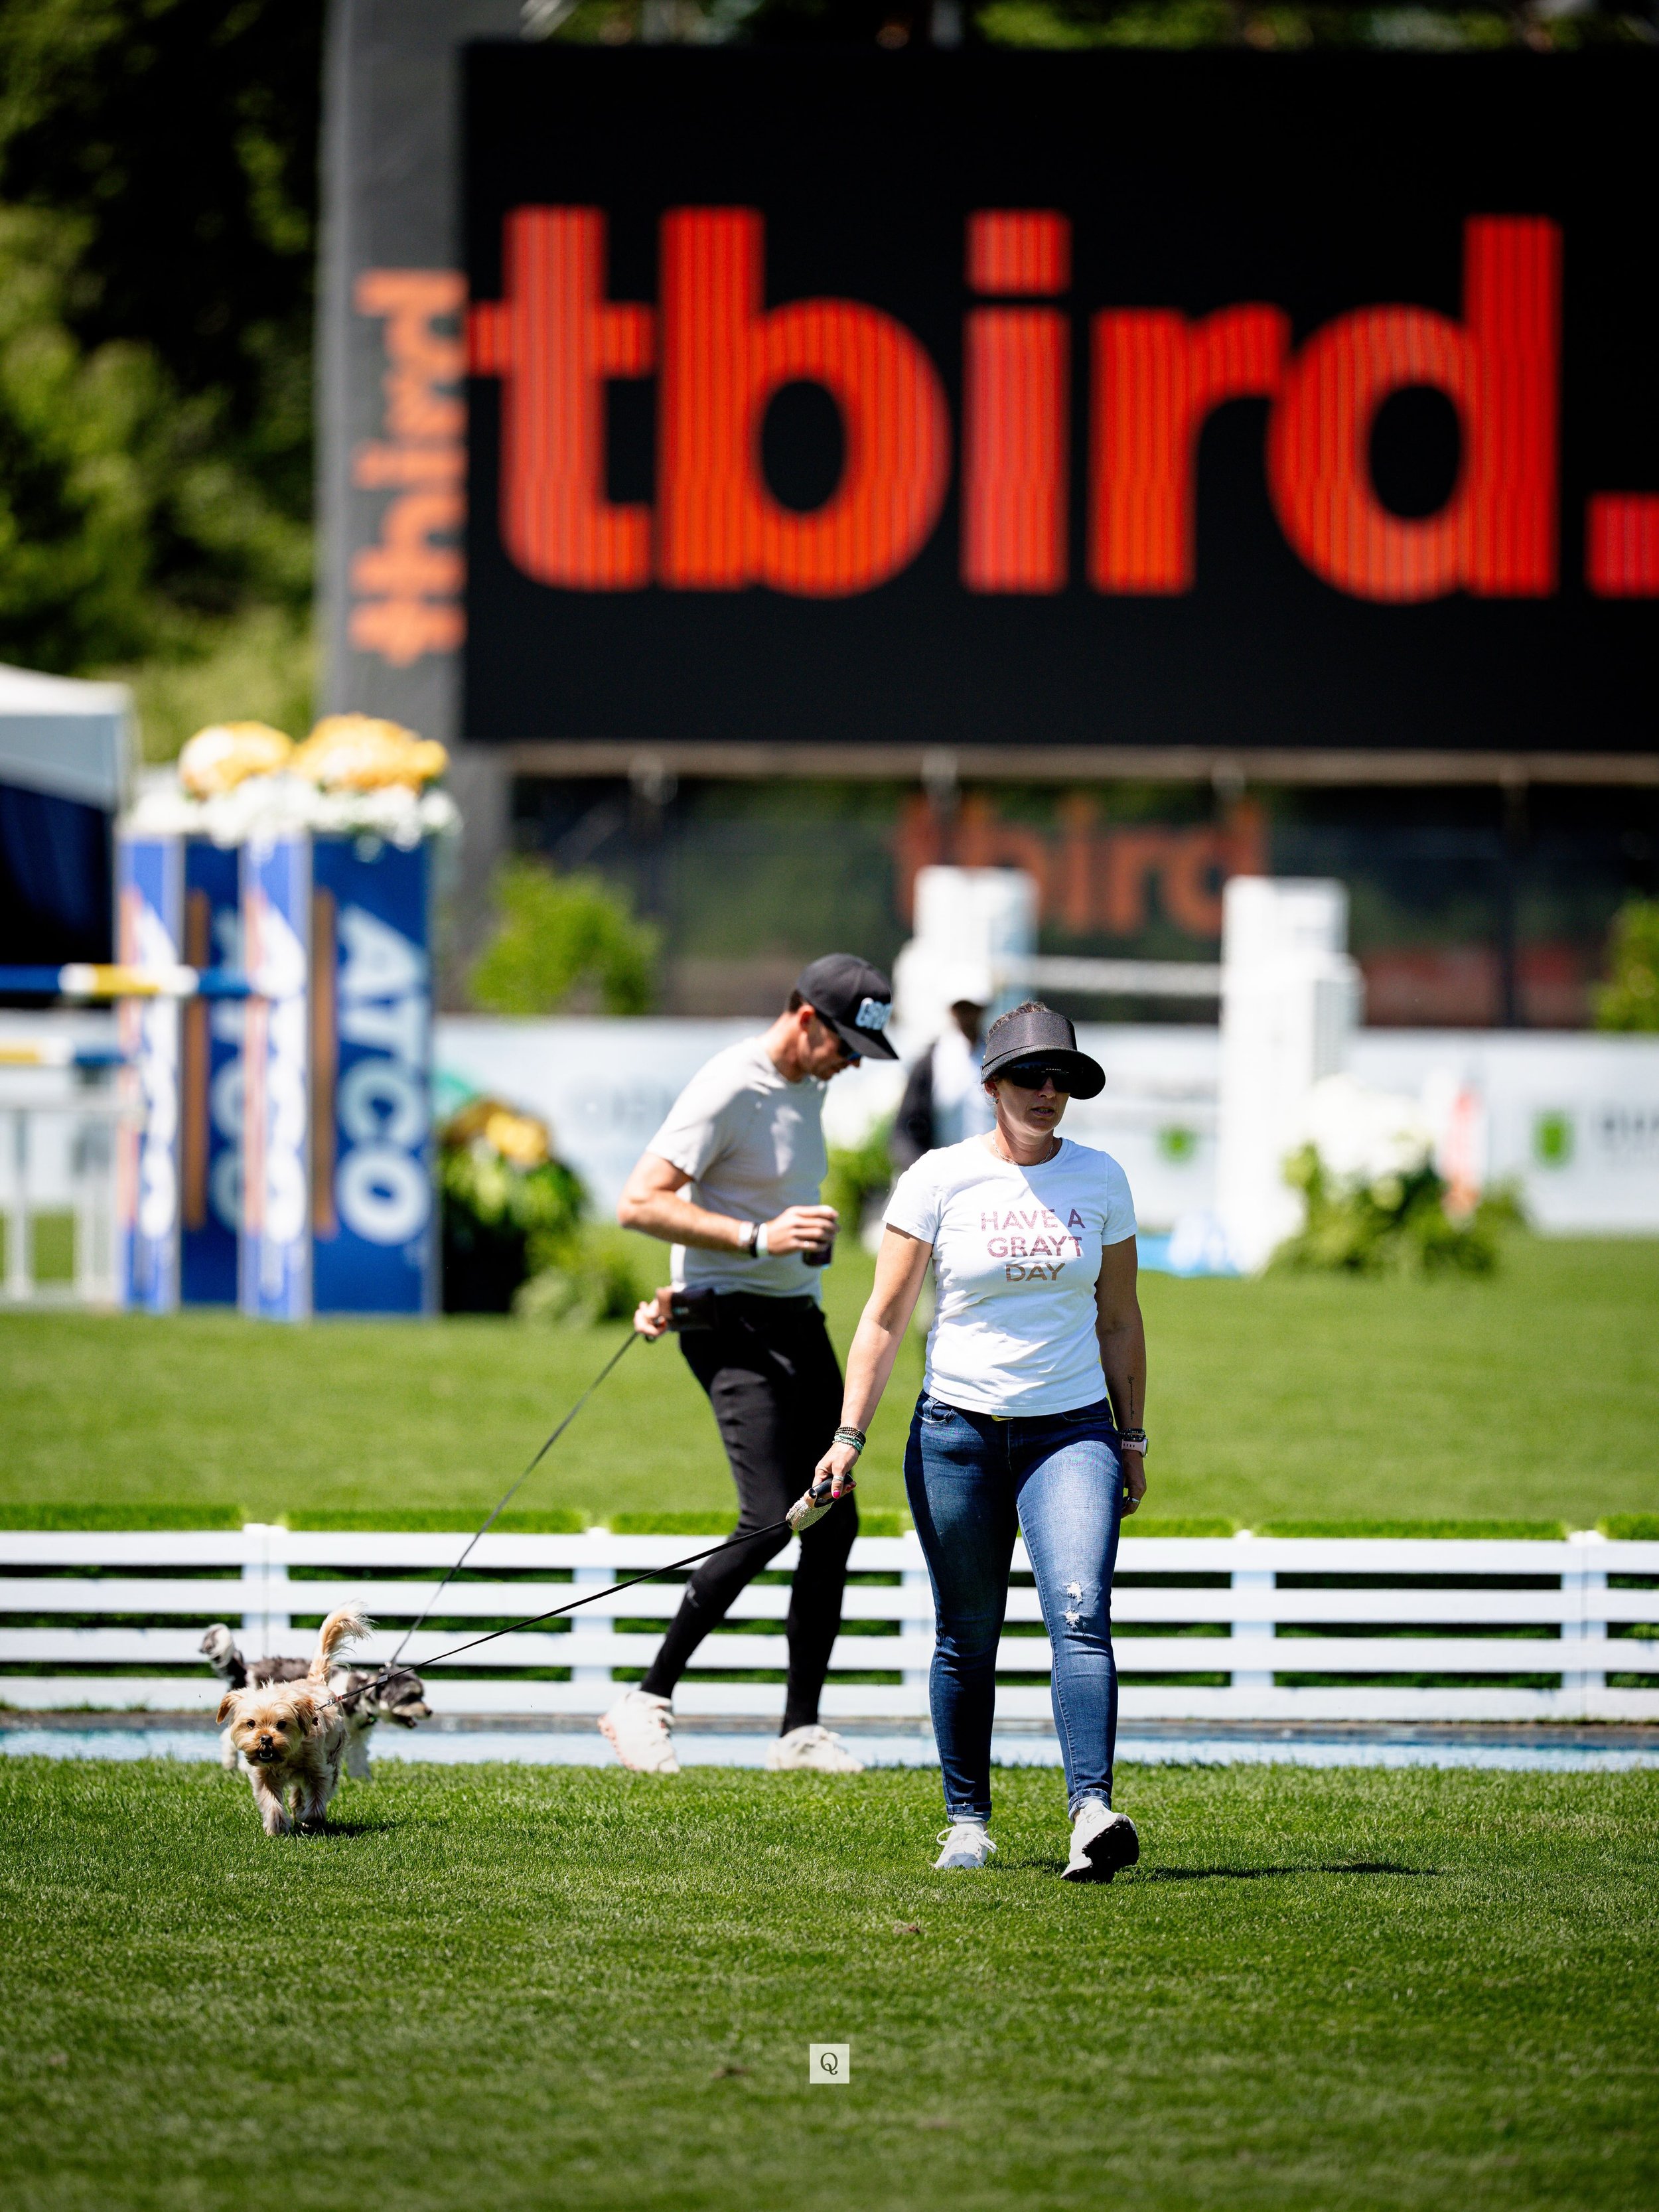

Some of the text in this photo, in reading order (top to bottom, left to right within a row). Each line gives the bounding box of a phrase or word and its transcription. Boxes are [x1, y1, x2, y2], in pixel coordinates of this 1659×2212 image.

[335, 903, 433, 1246] ATCO
[981, 1209, 1086, 1232] HAVE A
[987, 1235, 1082, 1258] GRAYT
[1005, 1262, 1065, 1282] DAY
